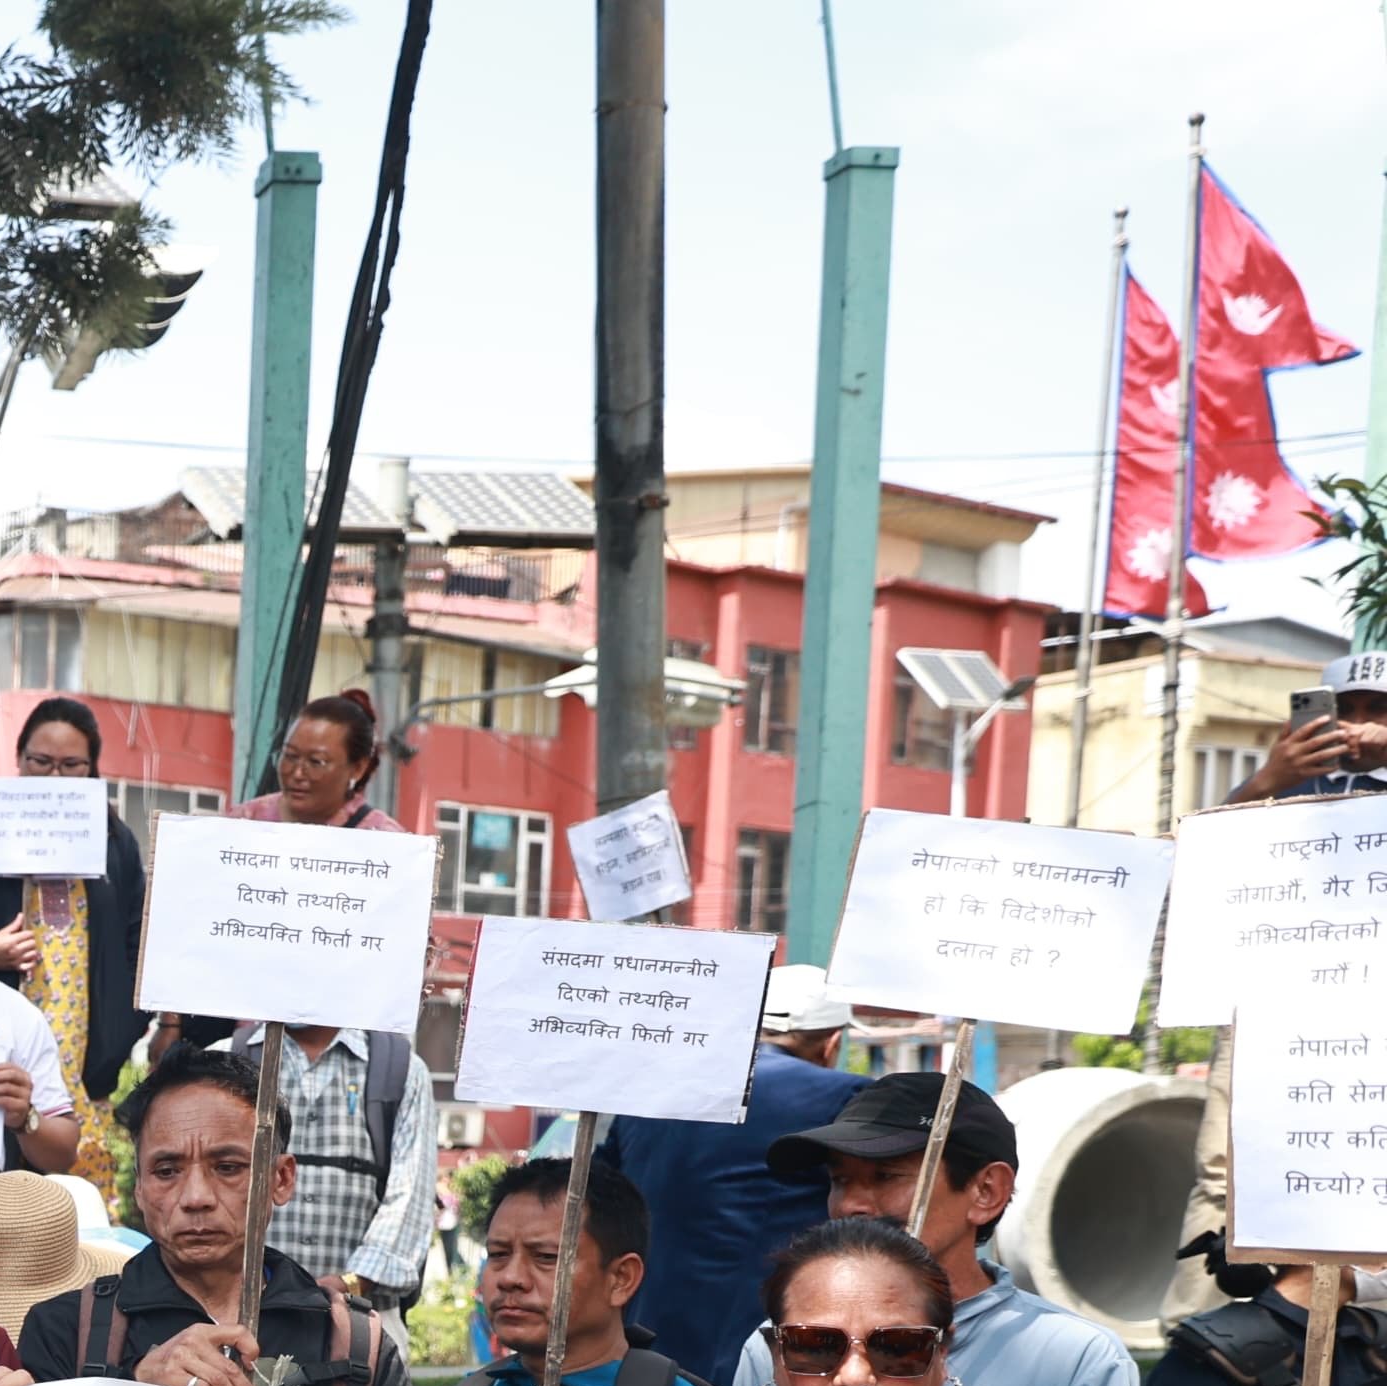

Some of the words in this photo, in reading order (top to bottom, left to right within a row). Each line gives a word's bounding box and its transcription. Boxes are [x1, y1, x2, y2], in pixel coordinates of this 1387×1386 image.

[1269, 832, 1342, 861] राष्ट्रको
[219, 845, 280, 870] संसदमा
[289, 856, 391, 880] प्रधानमन्त्रीले
[910, 846, 1001, 877] नेपालको
[1012, 857, 1131, 890] प्रधानमन्त्री
[237, 883, 289, 906] दिएको
[297, 891, 367, 914] तथ्यहिन
[1322, 875, 1355, 897] गैर
[923, 894, 946, 916] हो
[958, 891, 987, 920] कि
[1000, 896, 1097, 930] विदेशीको
[210, 918, 303, 945] अभिव्यक्ति
[312, 926, 353, 949] फिर्ता
[360, 934, 385, 953] गर
[1235, 916, 1382, 947] अभिव्यक्तिको
[541, 946, 603, 970] संसदमा
[613, 954, 720, 979] प्रधानमन्त्रीले
[936, 937, 996, 962] दलाल
[1010, 943, 1031, 969] हो
[1046, 948, 1061, 968] ?
[1362, 964, 1369, 984] !
[557, 981, 609, 1004] दिएको
[618, 989, 691, 1012] तथ्यहिन
[528, 1015, 622, 1041] अभिव्यक्ति
[631, 1023, 675, 1045] फिर्ता
[682, 1031, 709, 1049] गर
[1288, 1032, 1371, 1058] नेपालले
[1287, 1079, 1335, 1104] कति
[1286, 1131, 1334, 1150] गएर
[1285, 1170, 1365, 1195] मिच्यो?
